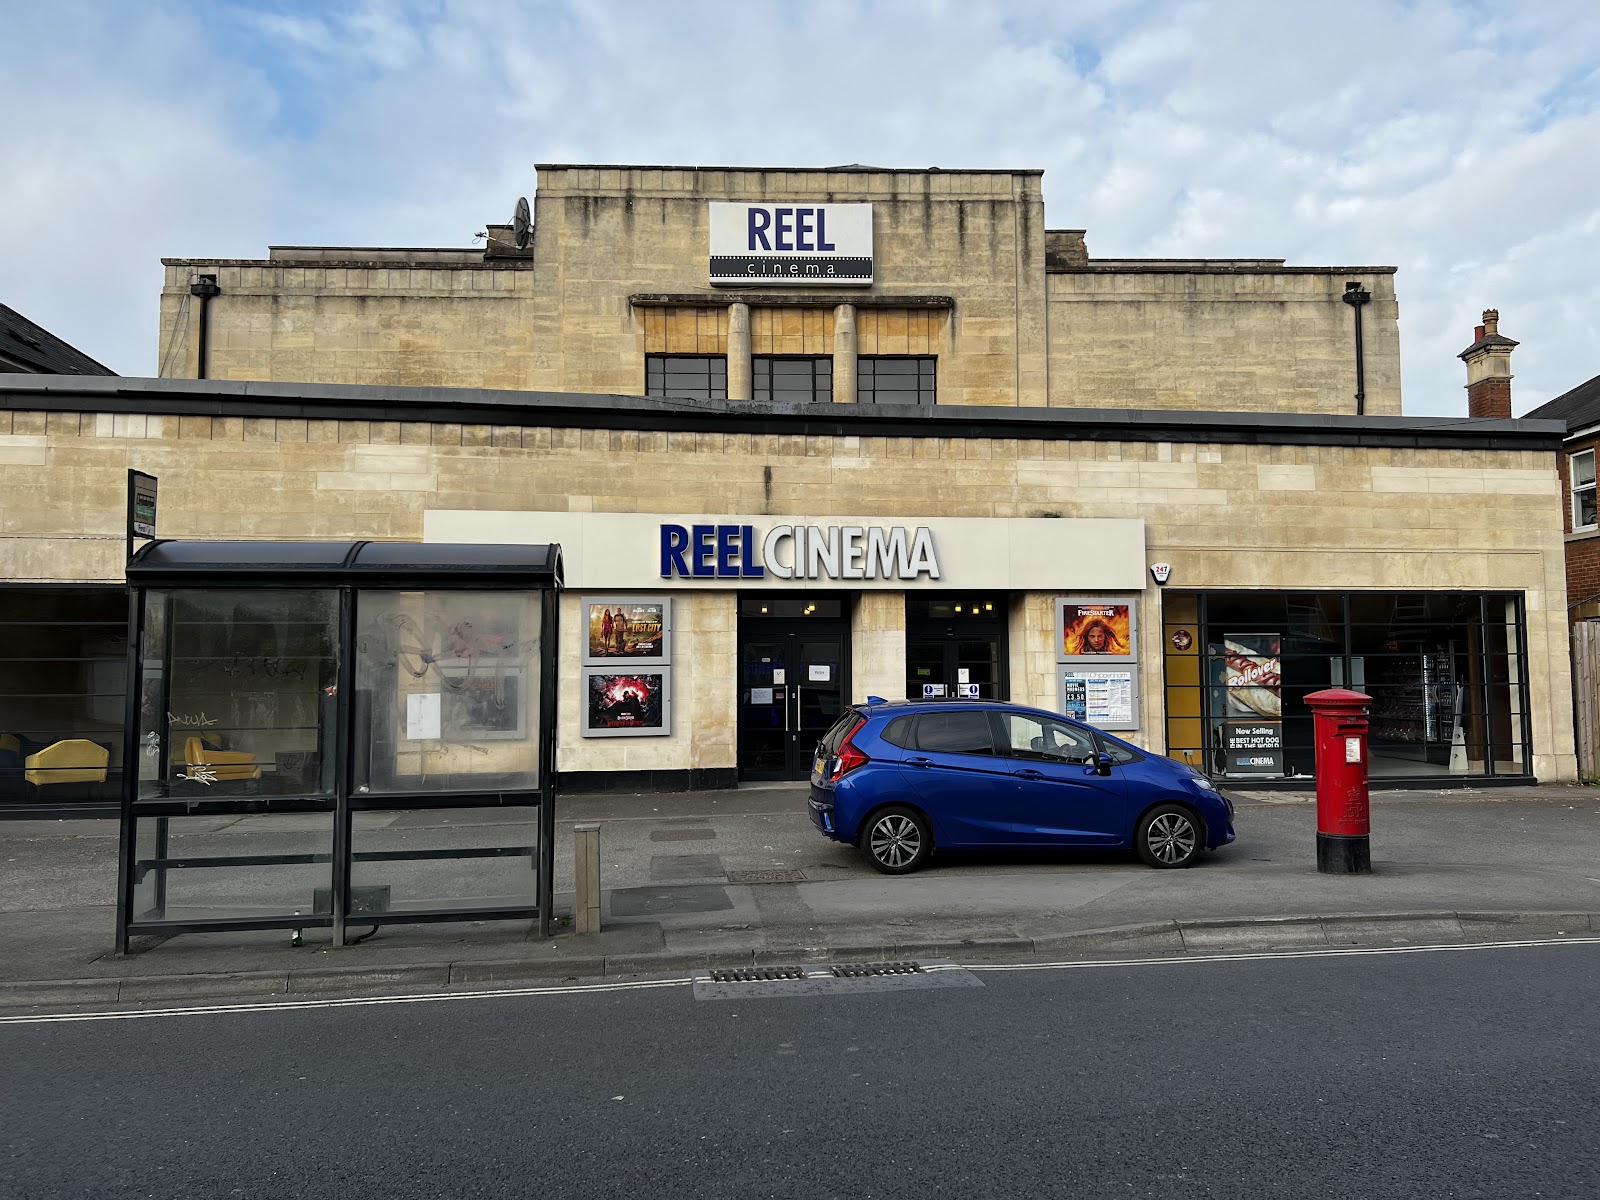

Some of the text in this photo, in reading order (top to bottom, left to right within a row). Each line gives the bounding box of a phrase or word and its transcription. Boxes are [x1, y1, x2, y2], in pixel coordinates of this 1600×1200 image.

[748, 207, 835, 251] REEL
[747, 260, 835, 274] cinema
[632, 624, 648, 632] LOST
[648, 624, 662, 632] CITY
[1228, 658, 1277, 692] Rollover
[1252, 727, 1273, 735] Selling
